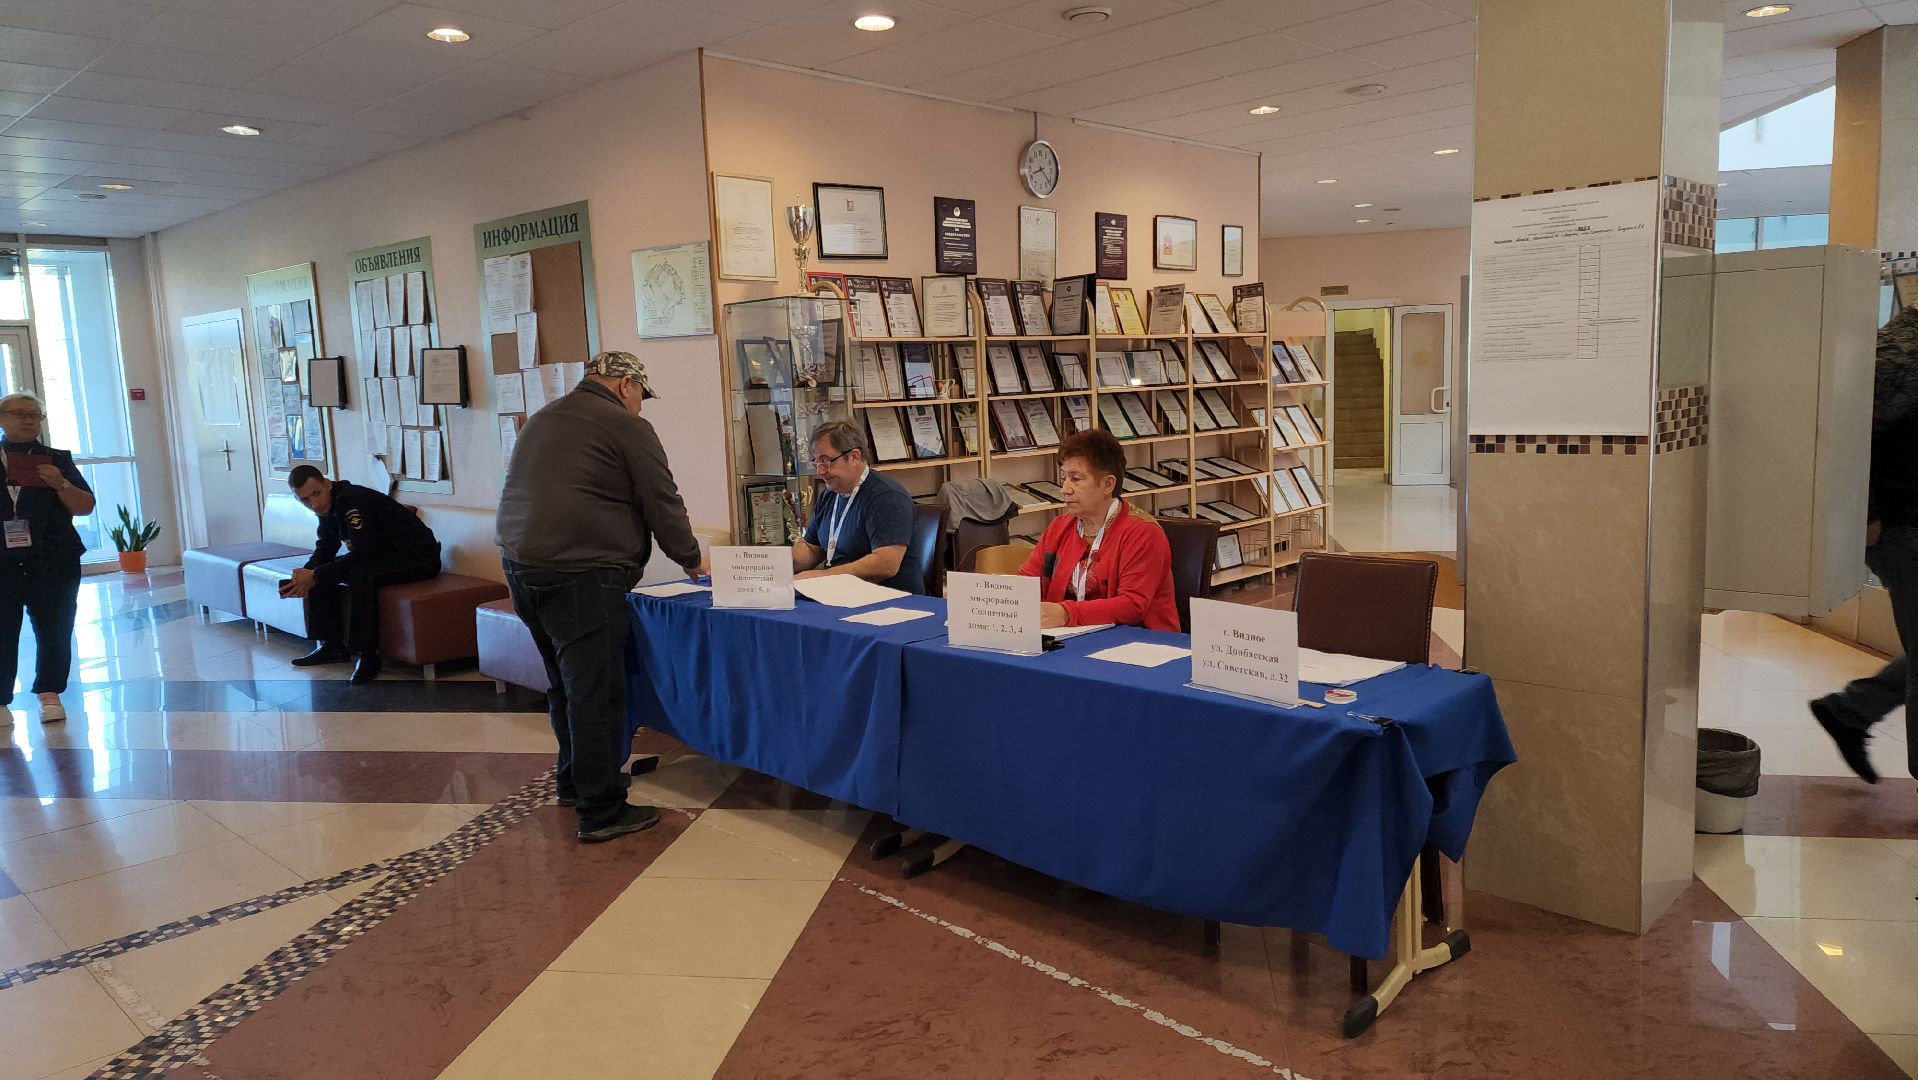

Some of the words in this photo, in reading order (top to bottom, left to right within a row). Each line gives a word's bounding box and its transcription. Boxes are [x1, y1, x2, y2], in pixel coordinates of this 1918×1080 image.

[483, 212, 580, 249] ИНФОРМАЦИЯ
[354, 246, 421, 274] ОБЪЯВЛЕНИЯ
[984, 580, 1014, 591] Видное
[971, 607, 1018, 619] Солнечный
[1233, 629, 1266, 643] Видное
[1226, 644, 1279, 664] Донбасская
[1217, 660, 1268, 681] Советская,
